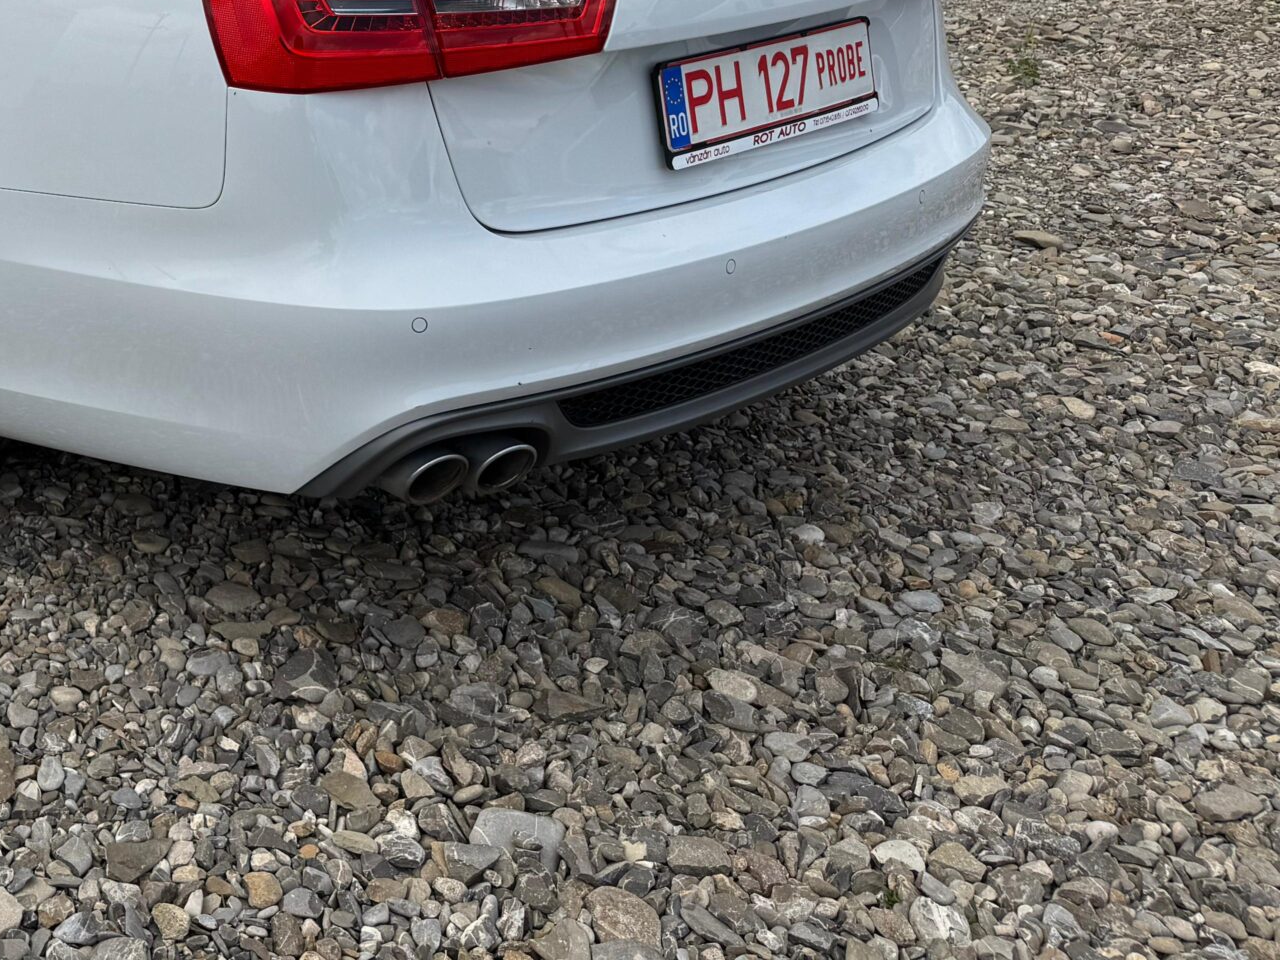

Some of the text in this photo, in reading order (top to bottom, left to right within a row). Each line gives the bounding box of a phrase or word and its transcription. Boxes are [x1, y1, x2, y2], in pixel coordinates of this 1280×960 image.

[685, 41, 866, 135] PH 127 PROBE
[669, 113, 688, 139] RO
[713, 145, 730, 157] auto
[753, 130, 775, 146] ROT
[777, 121, 807, 139] AUTO
